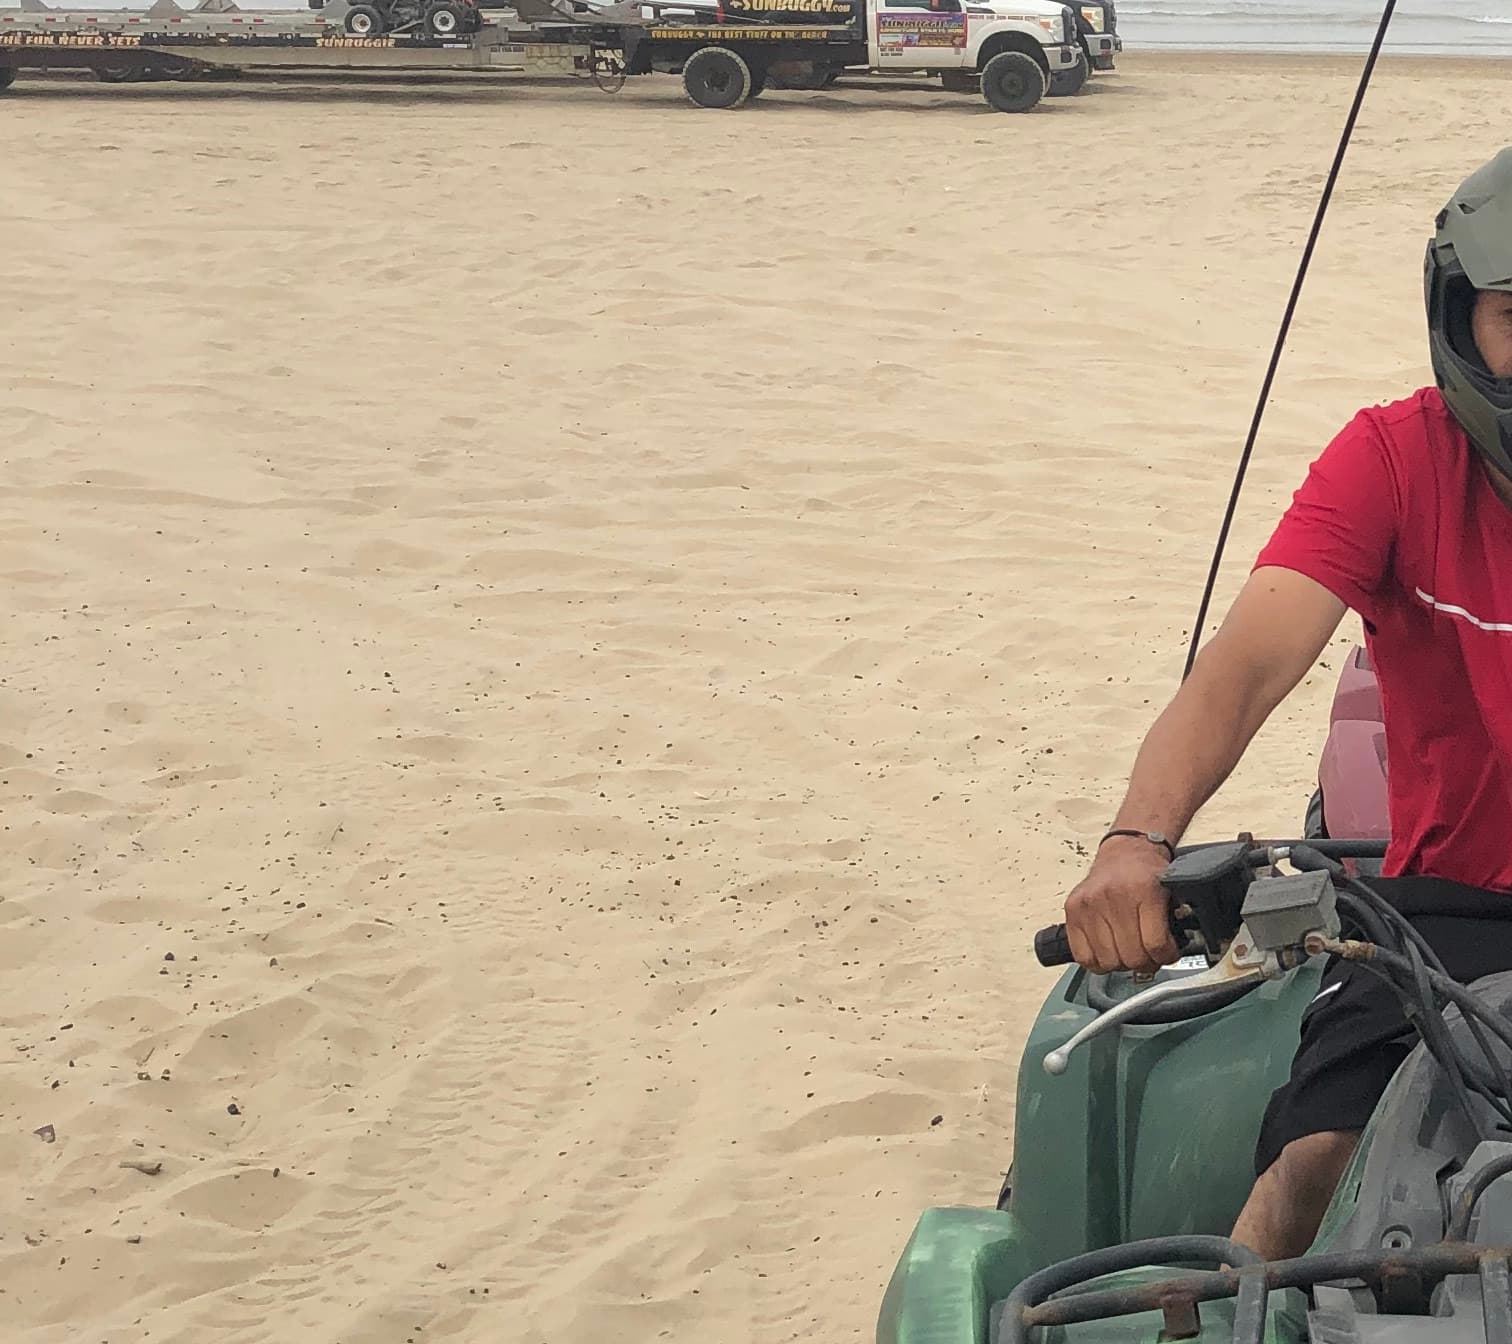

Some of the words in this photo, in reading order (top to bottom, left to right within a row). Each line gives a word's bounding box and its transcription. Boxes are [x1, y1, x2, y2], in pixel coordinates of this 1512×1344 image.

[26, 35, 55, 45] FUN
[59, 35, 104, 45] NEVER
[109, 35, 140, 45] SETS
